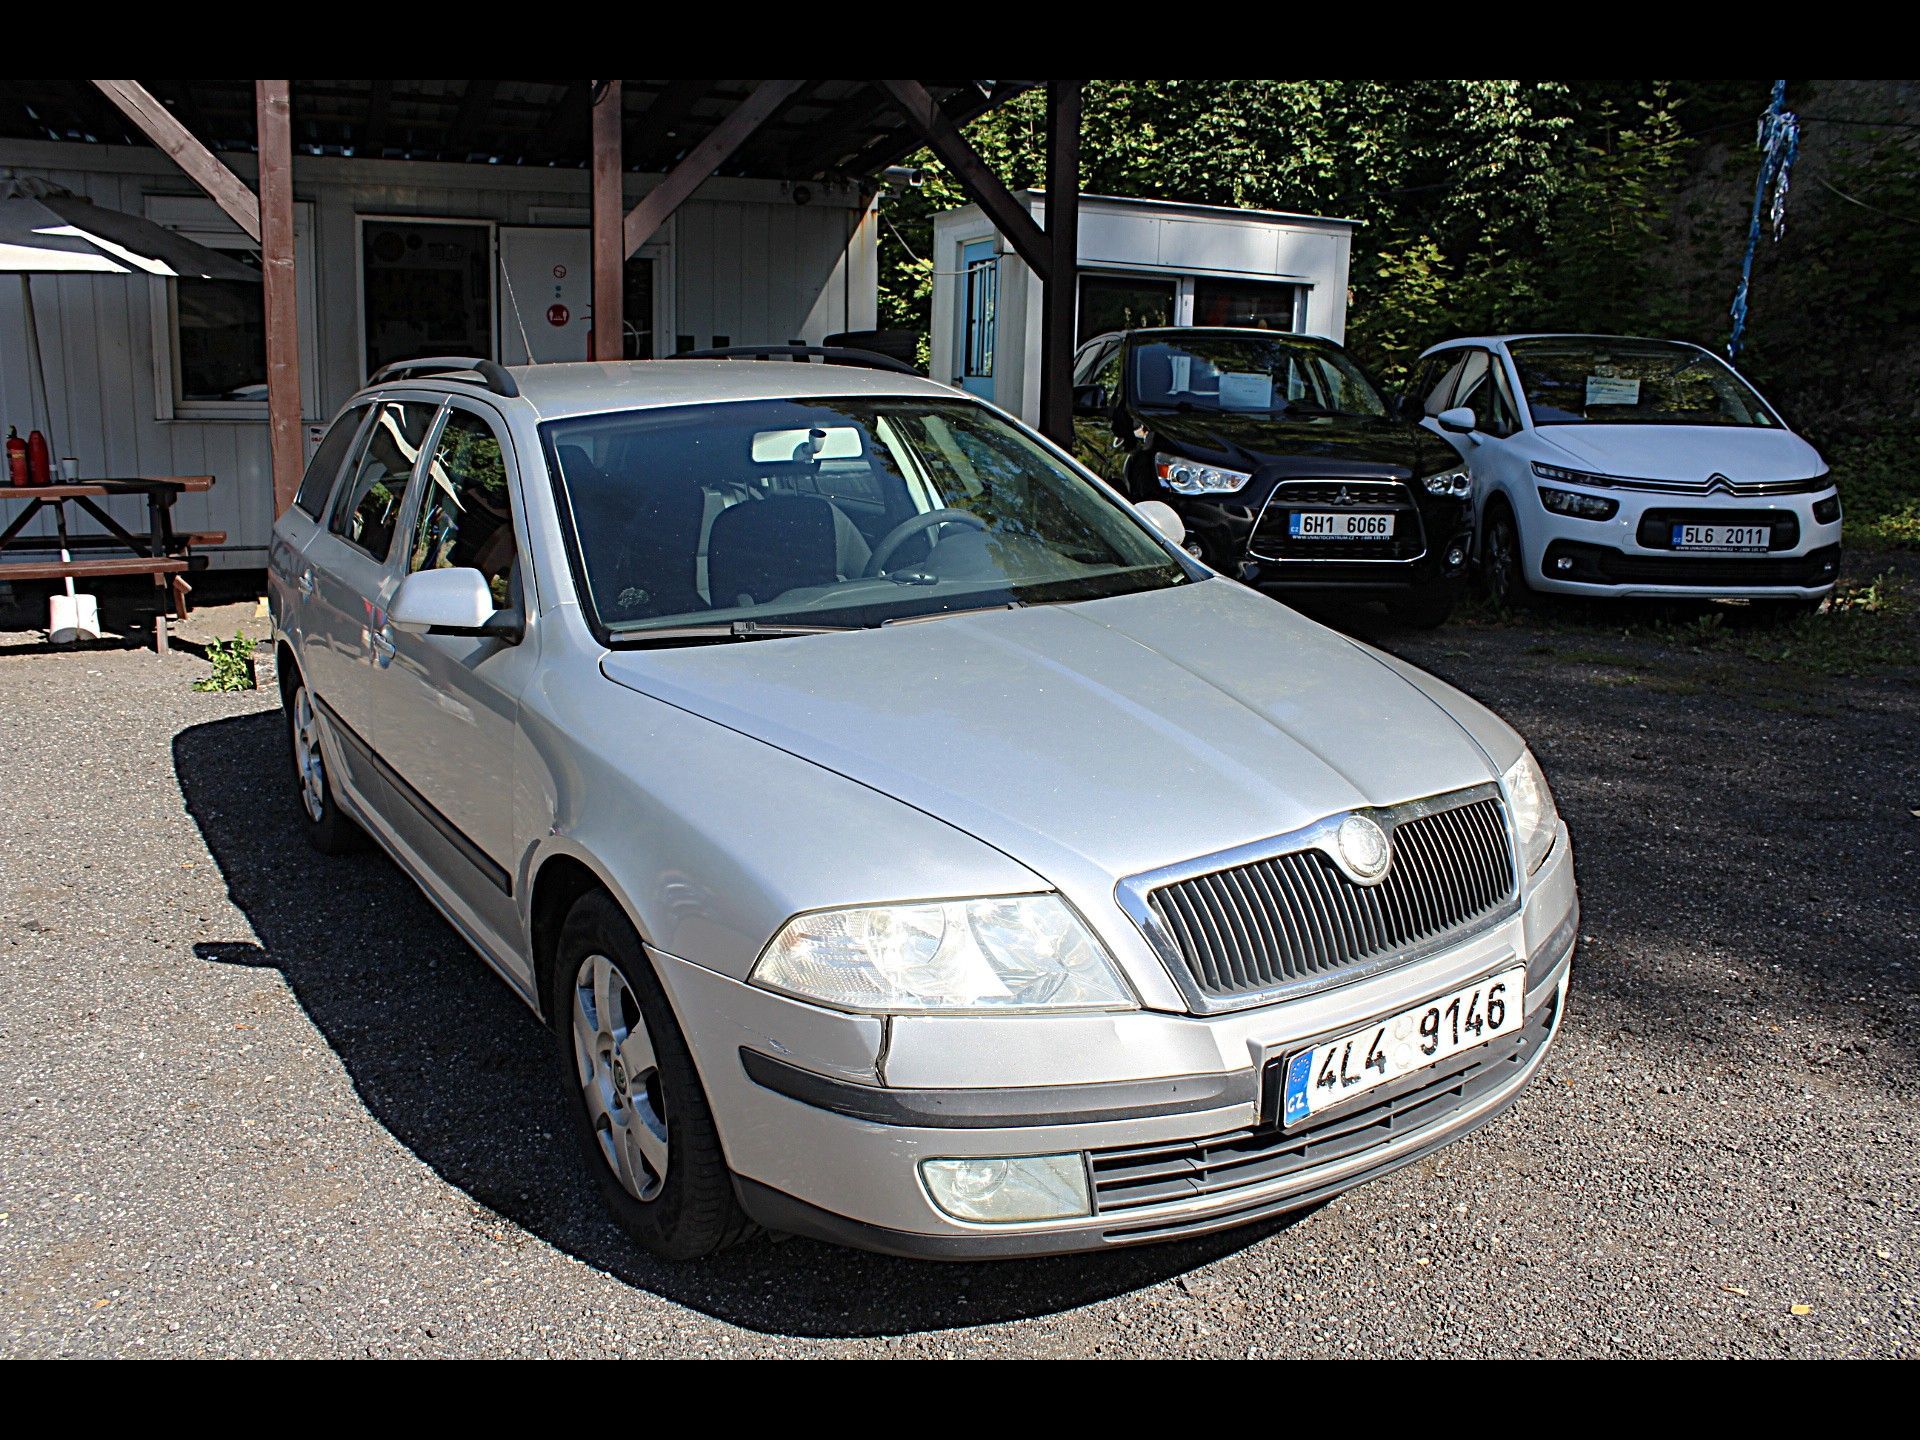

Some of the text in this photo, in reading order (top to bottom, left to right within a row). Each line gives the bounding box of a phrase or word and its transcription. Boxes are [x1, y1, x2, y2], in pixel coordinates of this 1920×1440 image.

[1303, 516, 1387, 534] 6H1 6066
[1685, 527, 1763, 544] 5L6 2011
[1316, 982, 1506, 1090] 4L4 9146
[1287, 1091, 1305, 1112] CZ
